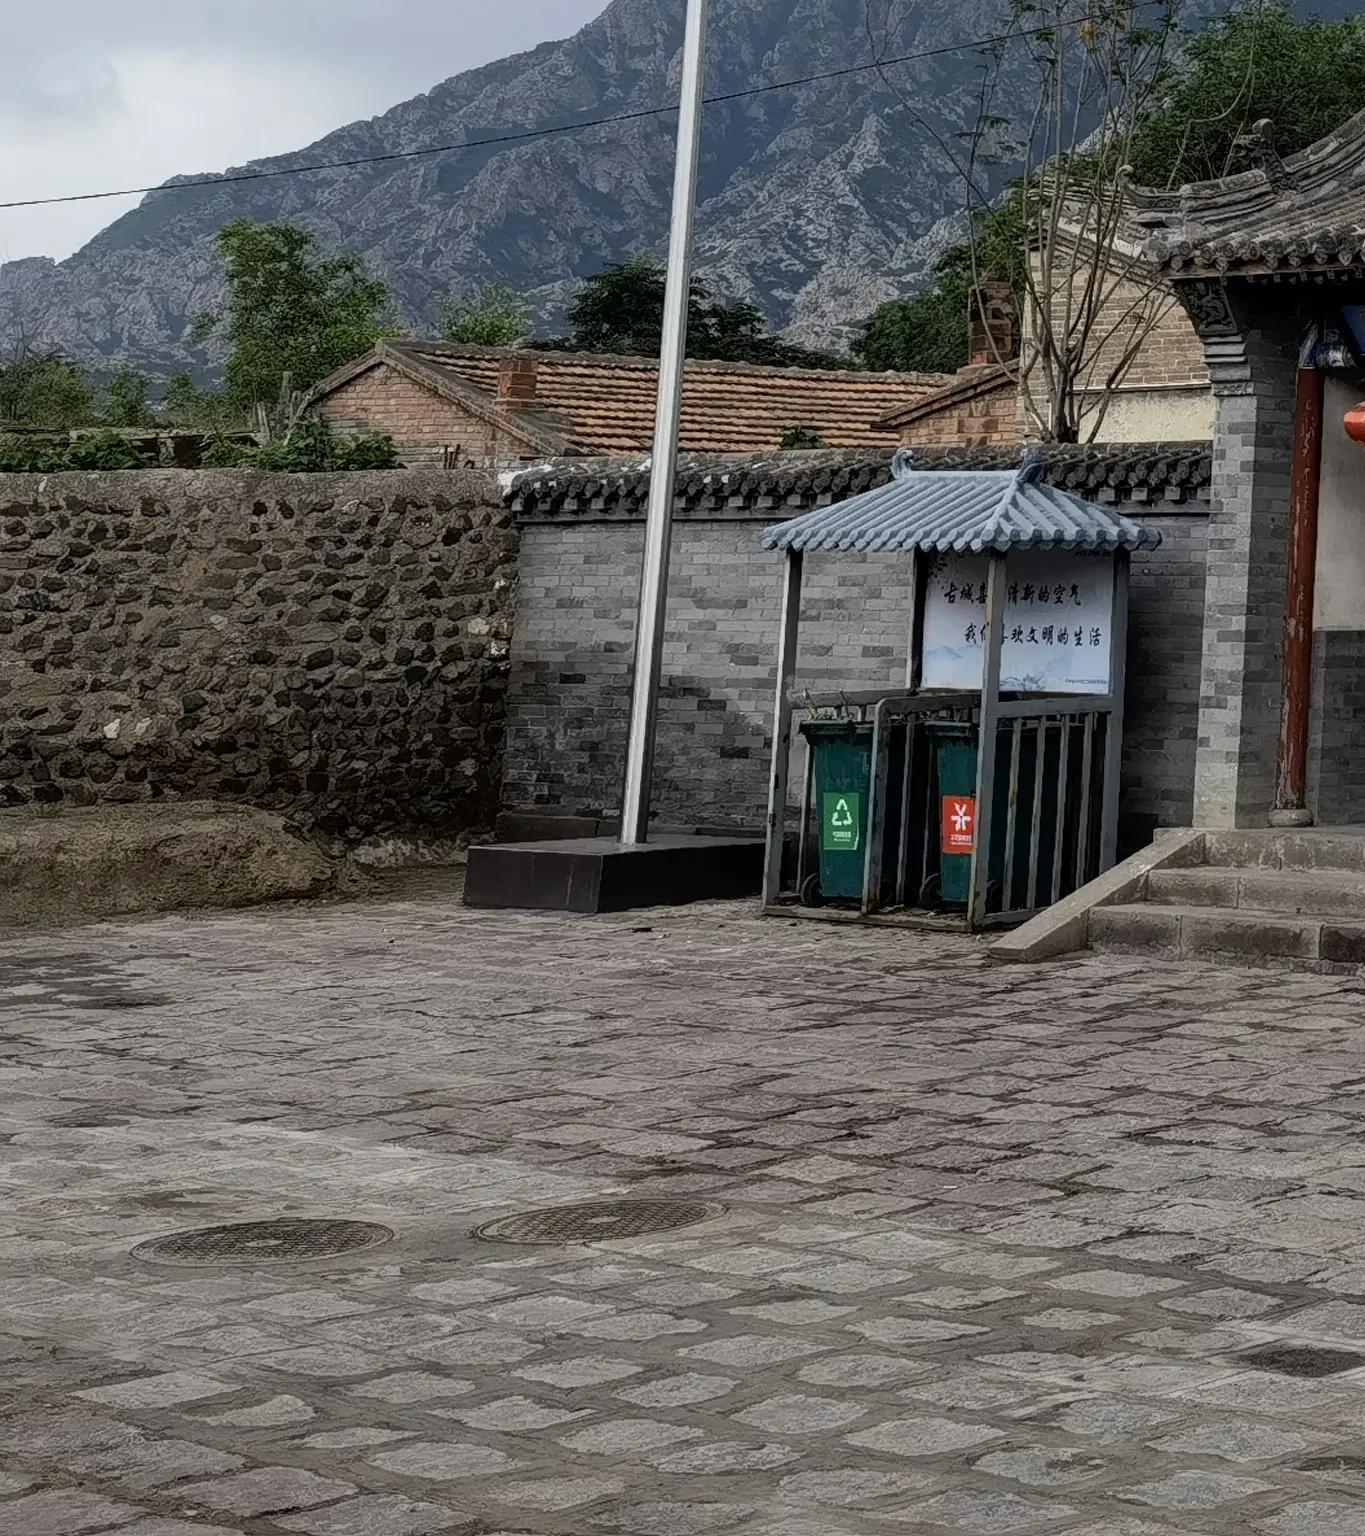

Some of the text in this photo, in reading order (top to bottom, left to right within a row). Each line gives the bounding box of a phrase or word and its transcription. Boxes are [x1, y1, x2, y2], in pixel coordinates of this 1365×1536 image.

[944, 580, 1081, 606] 古城喜清新的空气
